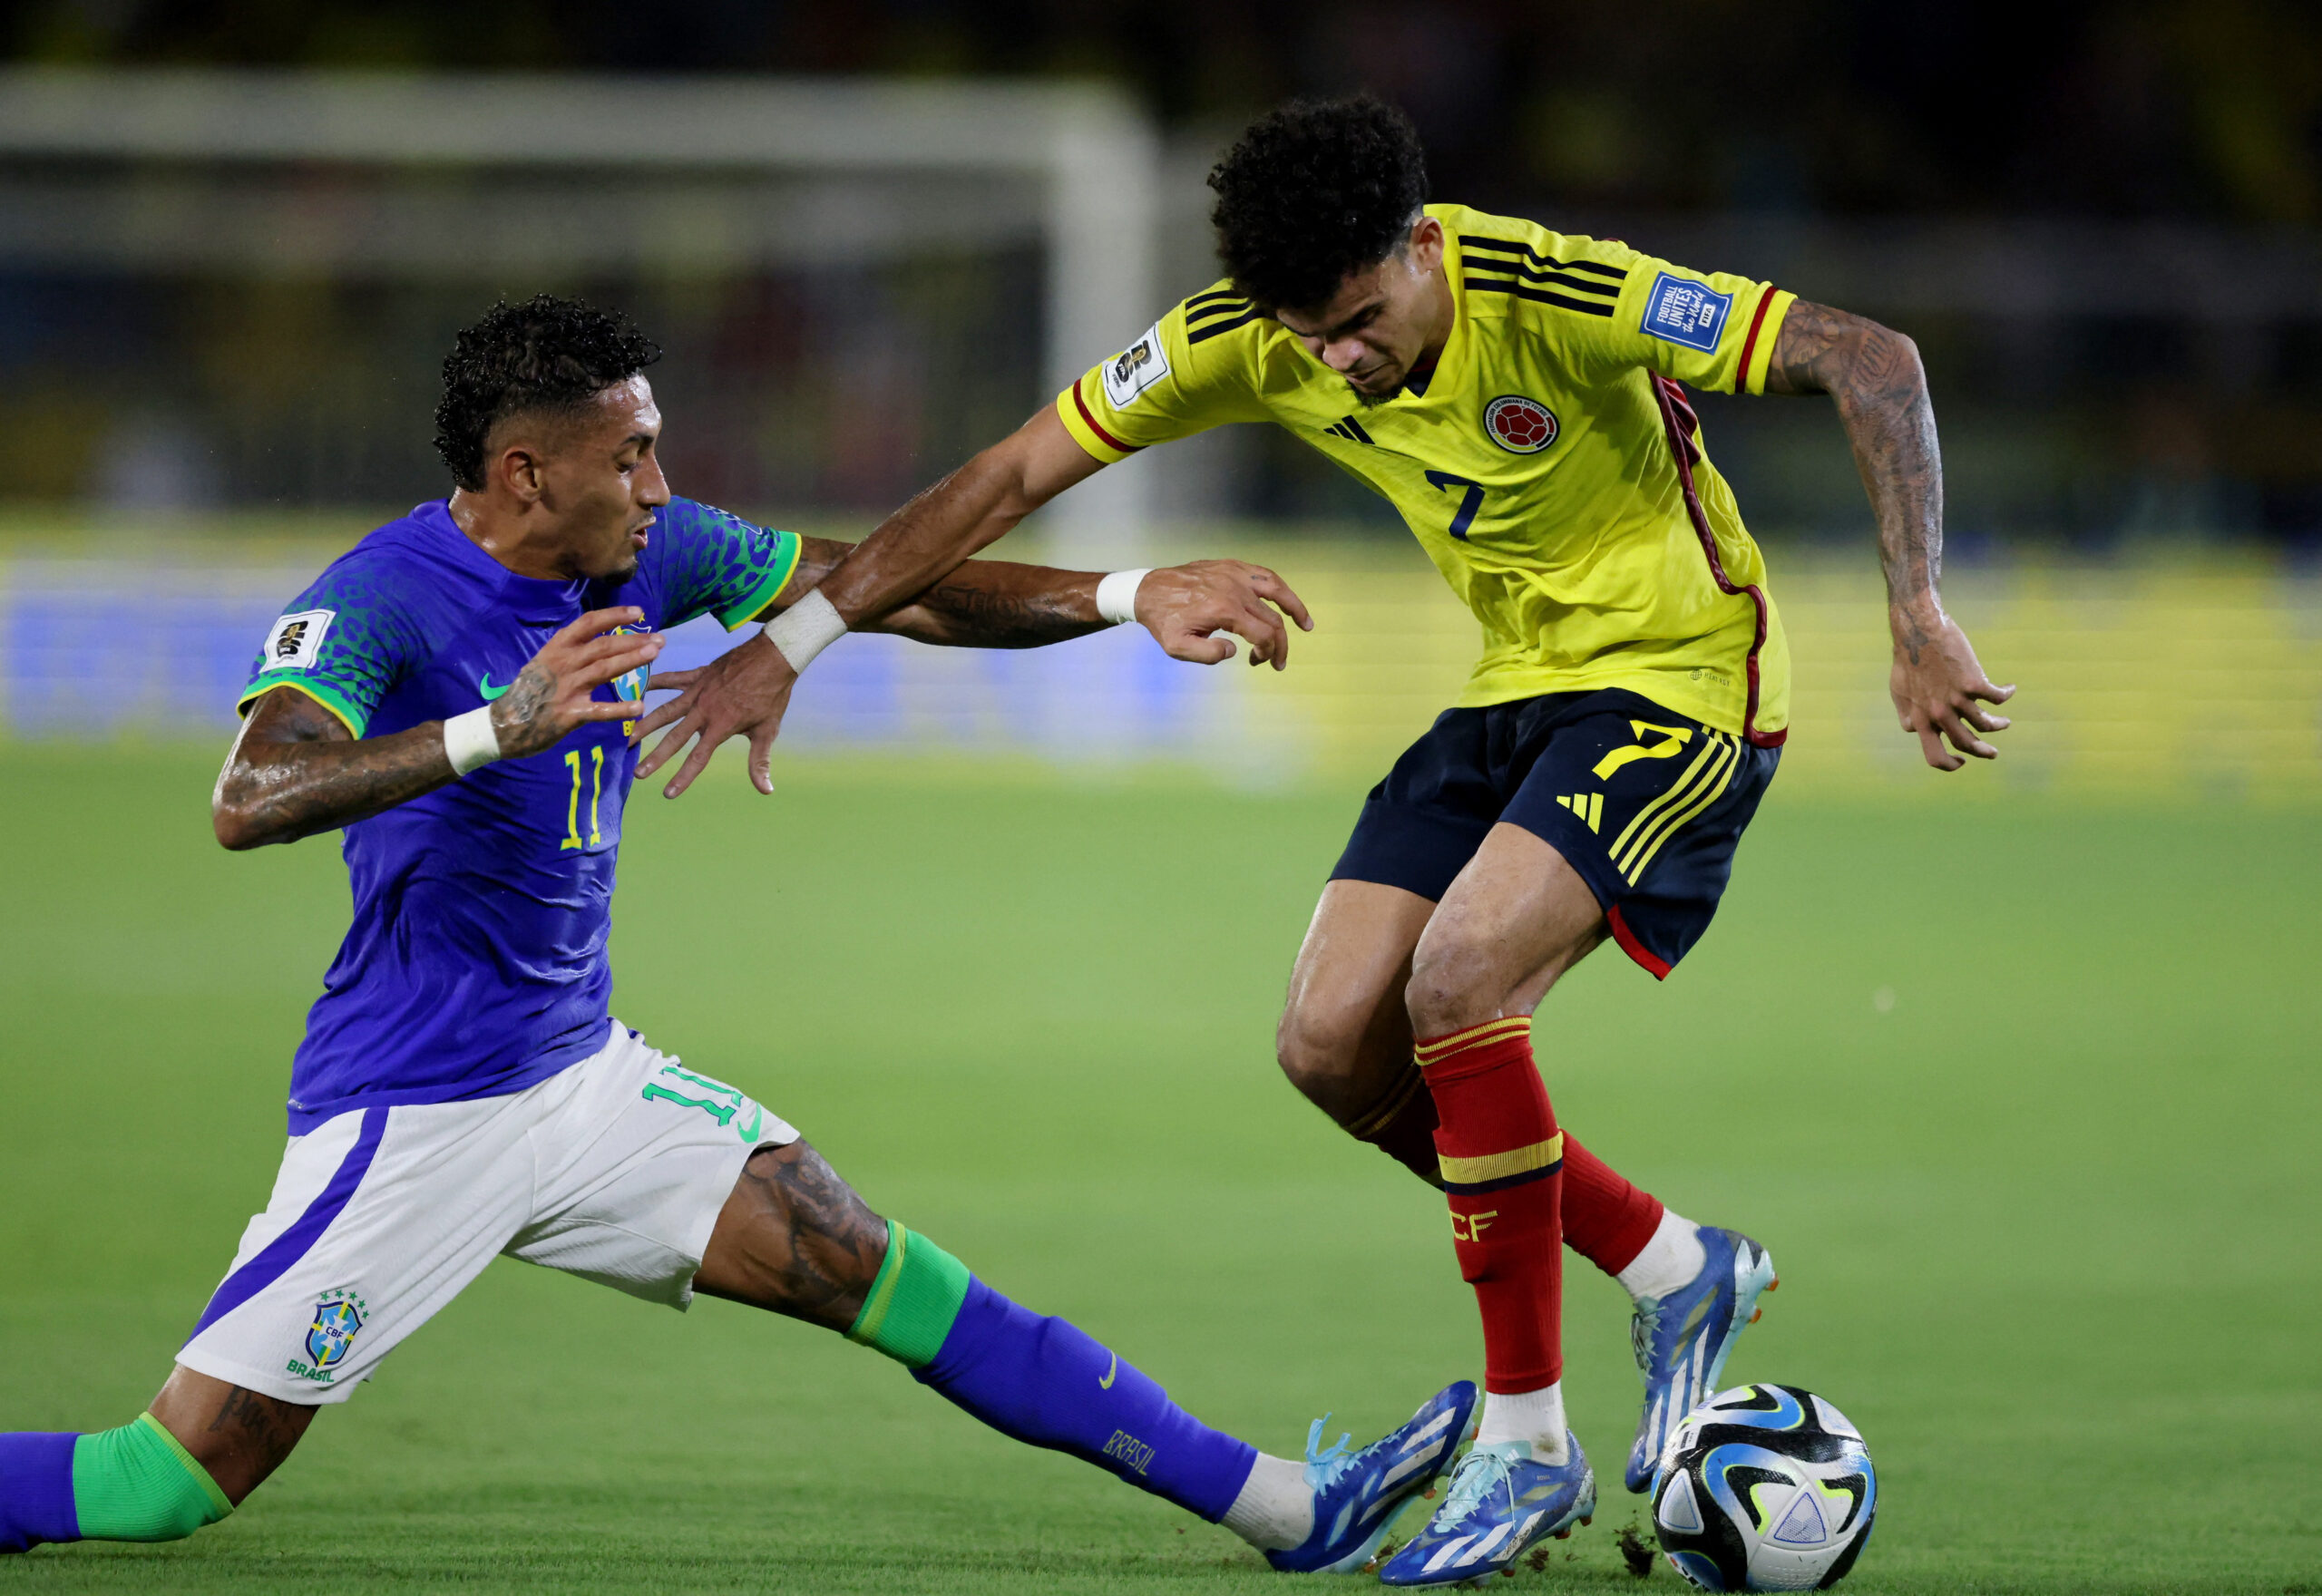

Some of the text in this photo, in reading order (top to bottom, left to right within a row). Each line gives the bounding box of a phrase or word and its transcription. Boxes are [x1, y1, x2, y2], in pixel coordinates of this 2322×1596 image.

[1656, 286, 1678, 323] FOOTBALL
[1667, 287, 1693, 327] UNITES
[1683, 290, 1706, 333] the World
[1702, 307, 1712, 324] FIFA
[1117, 363, 1126, 377] FIFA
[1424, 470, 1486, 542] 7
[1592, 719, 1693, 782] 7
[560, 744, 604, 851] 11
[642, 1066, 744, 1127] 11
[326, 1326, 344, 1339] CBF
[287, 1359, 335, 1383] BRASIL
[1102, 1429, 1156, 1476] BRASIL
